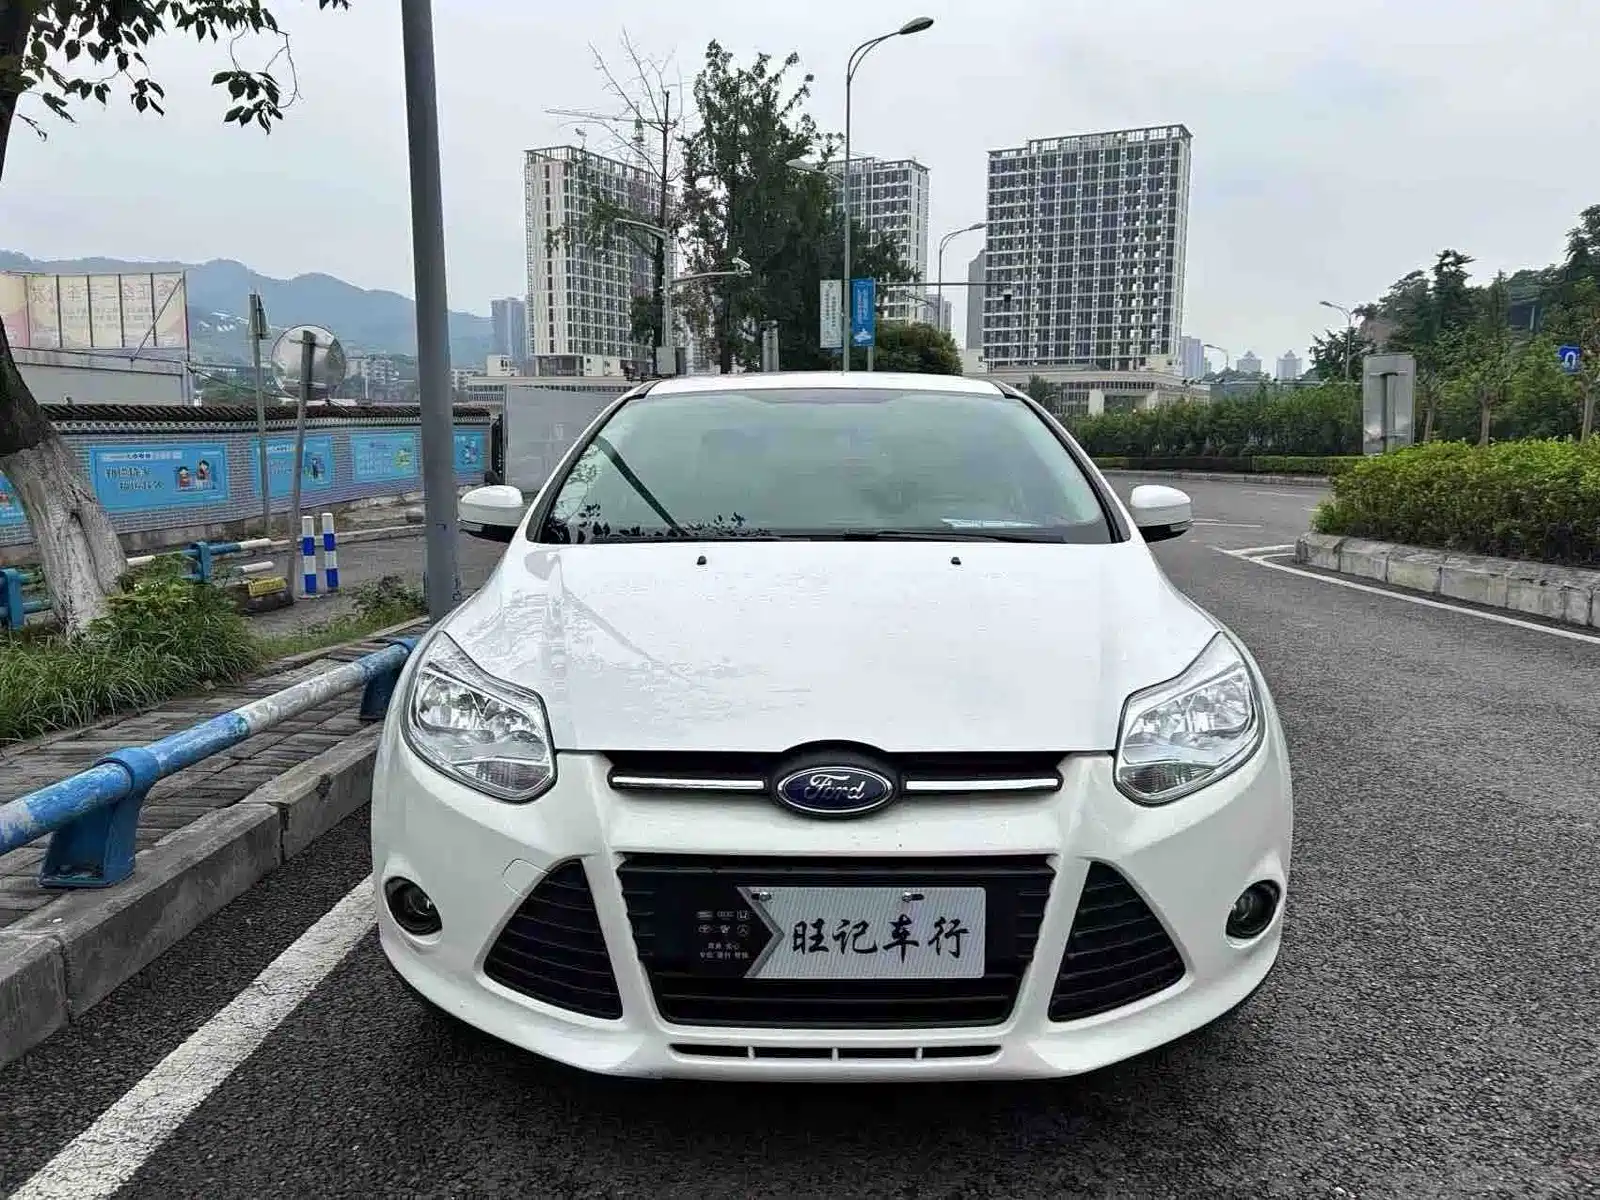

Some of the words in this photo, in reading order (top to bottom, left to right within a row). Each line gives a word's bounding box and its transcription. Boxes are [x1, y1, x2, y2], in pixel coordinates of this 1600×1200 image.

[804, 773, 866, 801] Ford
[791, 914, 969, 963] 旺记车行
